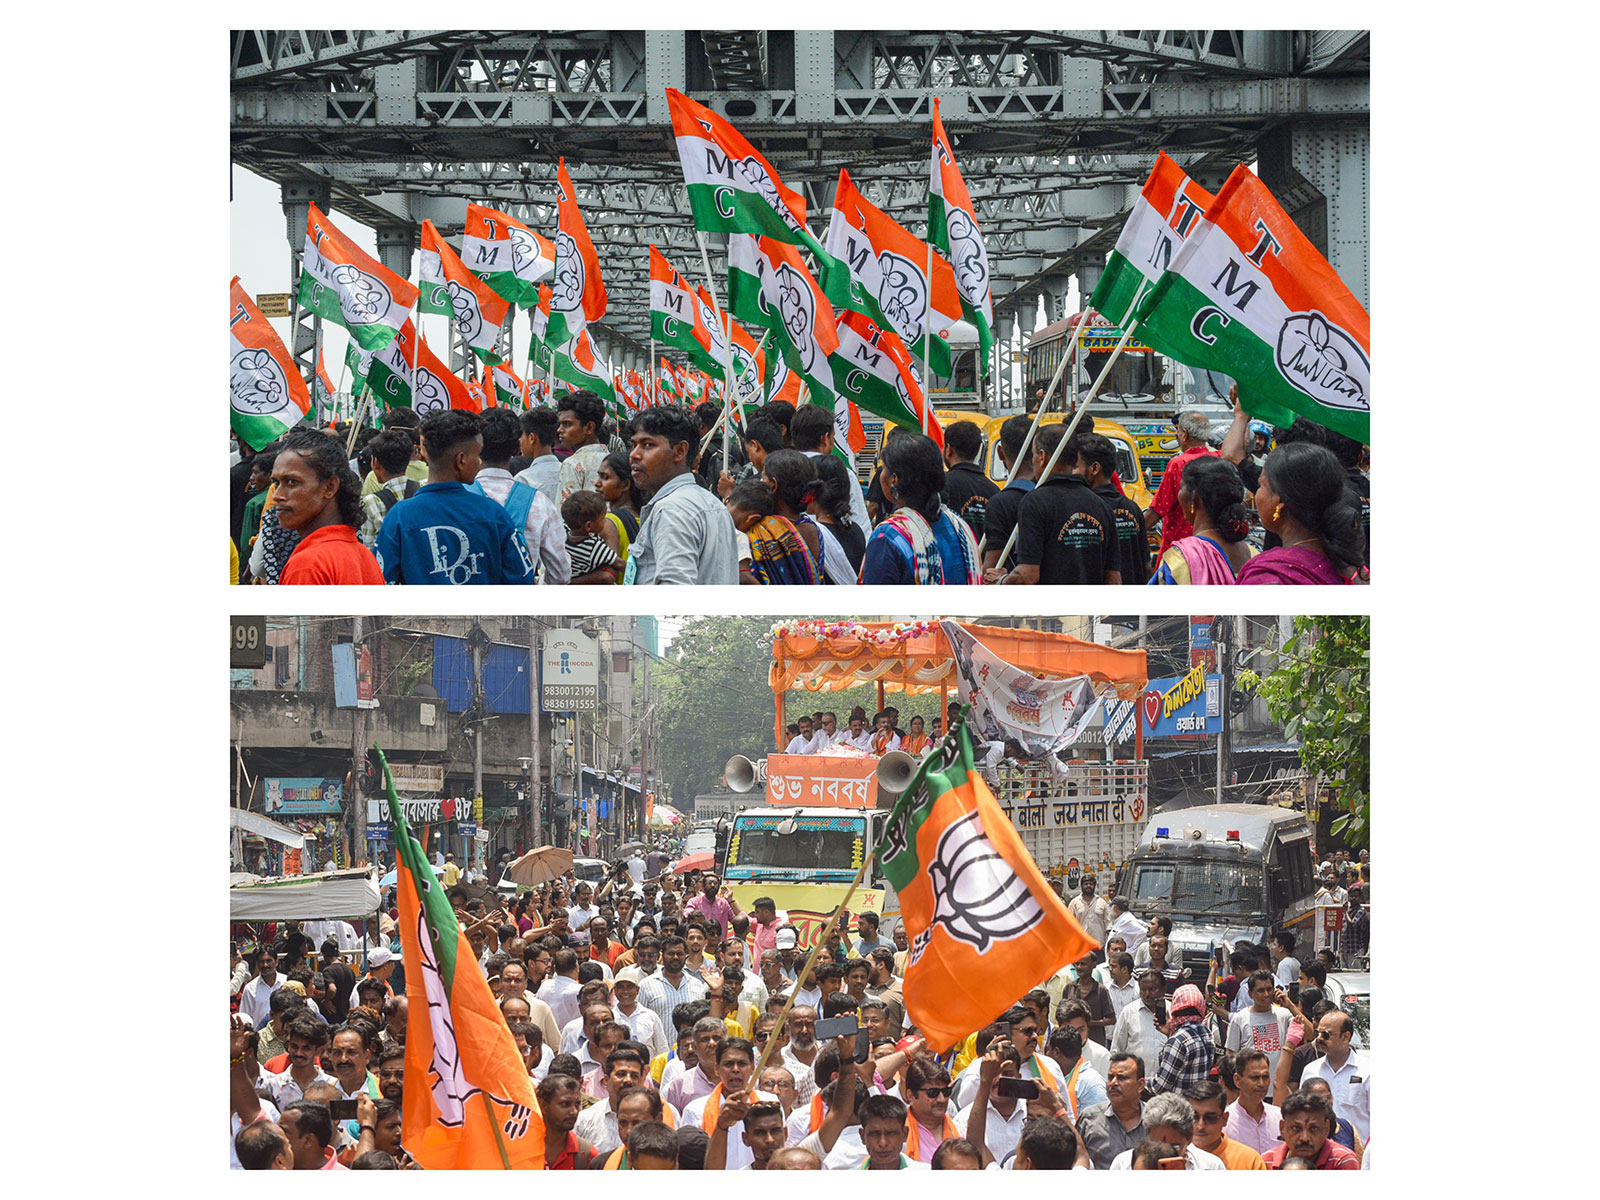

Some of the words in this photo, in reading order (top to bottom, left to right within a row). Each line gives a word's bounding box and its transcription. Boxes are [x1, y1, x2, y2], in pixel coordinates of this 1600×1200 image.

[313, 223, 330, 307] TMC
[1190, 217, 1283, 347] TMC
[845, 323, 884, 395] TMC
[1083, 338, 1145, 348] BADHAG
[544, 686, 596, 696] 9830012199
[544, 699, 595, 709] 9836191555
[768, 775, 804, 800] শুভ
[810, 769, 877, 804] নববর্ষ
[1018, 799, 1048, 828] बोलो
[1053, 802, 1080, 826] जय
[1081, 799, 1111, 824] माता
